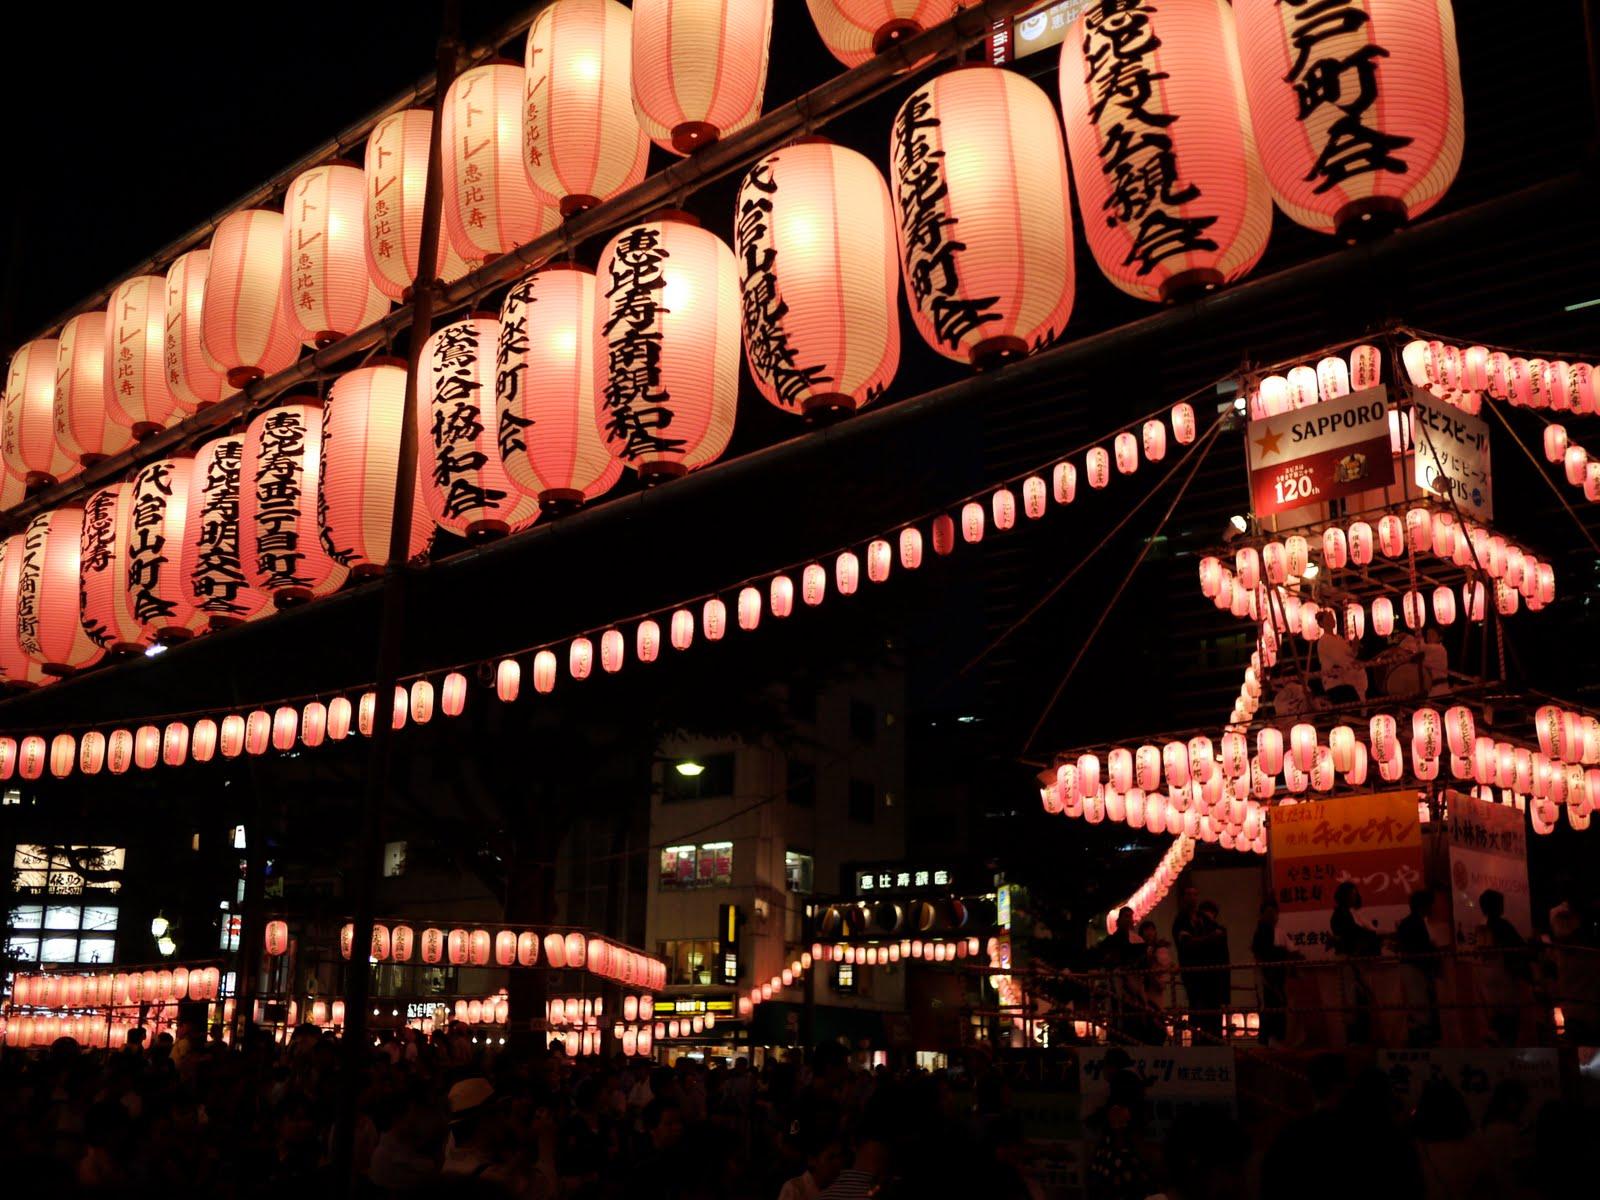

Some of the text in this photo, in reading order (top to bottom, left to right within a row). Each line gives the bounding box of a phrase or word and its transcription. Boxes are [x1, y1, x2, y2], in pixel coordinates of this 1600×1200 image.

[462, 71, 491, 230] アトレ恵比寿
[1275, 0, 1415, 195] 戸町会
[893, 92, 1003, 350] 東恵比寿町会
[602, 227, 688, 461] 恵比寿南親和会
[1292, 401, 1385, 442] SAPPORO
[128, 463, 178, 626] 代官山町会
[1426, 465, 1468, 500] CPIS
